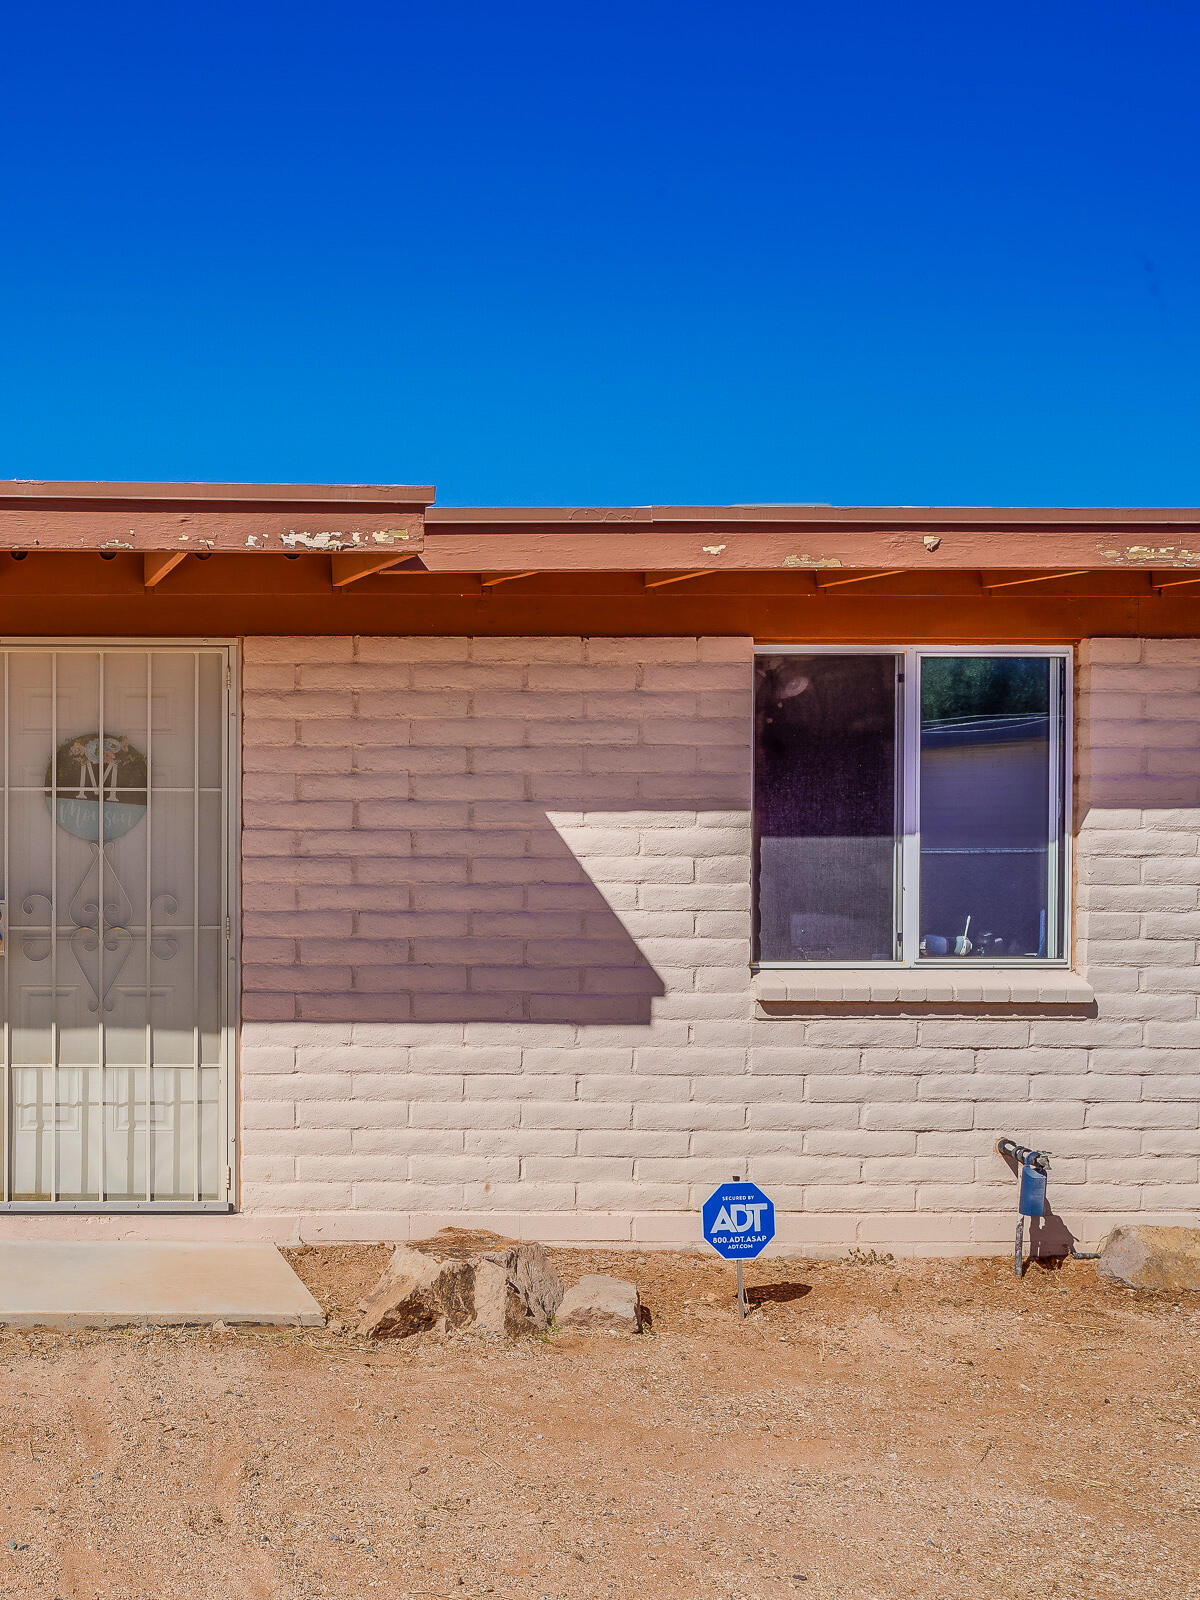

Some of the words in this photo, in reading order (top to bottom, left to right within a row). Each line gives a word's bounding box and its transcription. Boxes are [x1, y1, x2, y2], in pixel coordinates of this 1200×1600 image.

[75, 760, 120, 802] M
[710, 1203, 768, 1234] ADT
[712, 1235, 767, 1244] 800.ADT.ASAP
